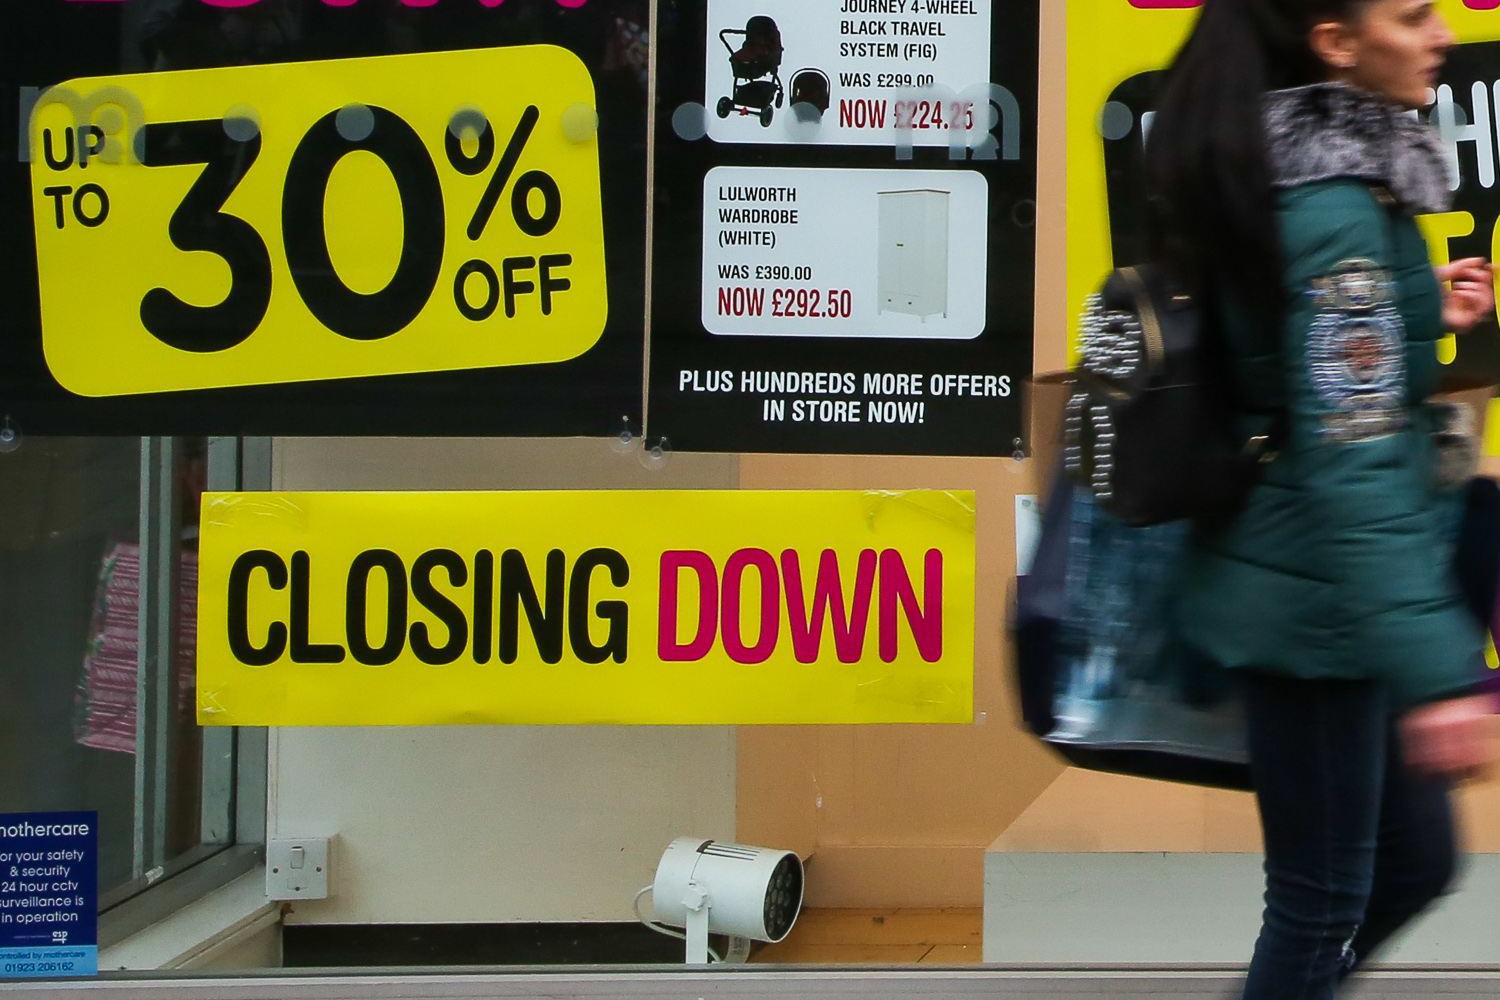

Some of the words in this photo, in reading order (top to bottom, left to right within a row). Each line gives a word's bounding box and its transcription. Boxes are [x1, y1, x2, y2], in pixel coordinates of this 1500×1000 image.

[911, 0, 977, 14] 4-WHEEL
[841, 21, 886, 35] BLACK
[891, 22, 946, 36] TRAVEL
[840, 43, 898, 57] SYSTEM
[904, 44, 936, 61] (FIG)
[840, 73, 870, 87] WAS
[877, 74, 933, 87] £299.00
[839, 99, 887, 129] NOW
[894, 100, 974, 130] £224.25
[43, 125, 105, 171] UP
[720, 187, 796, 201] LULWORTH
[44, 184, 109, 229] TO
[719, 209, 798, 223] WARDROBE
[719, 231, 775, 249] (WHITE)
[718, 265, 749, 279] WAS
[756, 266, 811, 280] £390.00
[454, 254, 572, 321] OFF
[719, 287, 764, 316] NOW
[772, 289, 851, 318] £292.50
[680, 370, 733, 392] PLUS
[741, 371, 855, 394] HUNDREDS
[863, 373, 923, 395] MORE
[930, 374, 1010, 396] OFFERS
[764, 400, 784, 421] IN
[792, 400, 860, 422] STORE
[868, 401, 924, 423] NOW!
[228, 548, 629, 666] CLOSING
[658, 548, 944, 664] DOWN
[0, 852, 12, 861] or
[16, 852, 43, 864] your
[47, 850, 84, 862] safety
[10, 866, 18, 876] &
[22, 866, 70, 878] security
[2, 882, 16, 892] 24
[20, 882, 48, 892] hour
[52, 880, 78, 891] cctv
[75, 896, 84, 905] is
[2, 913, 12, 922] in
[17, 912, 78, 924] operation
